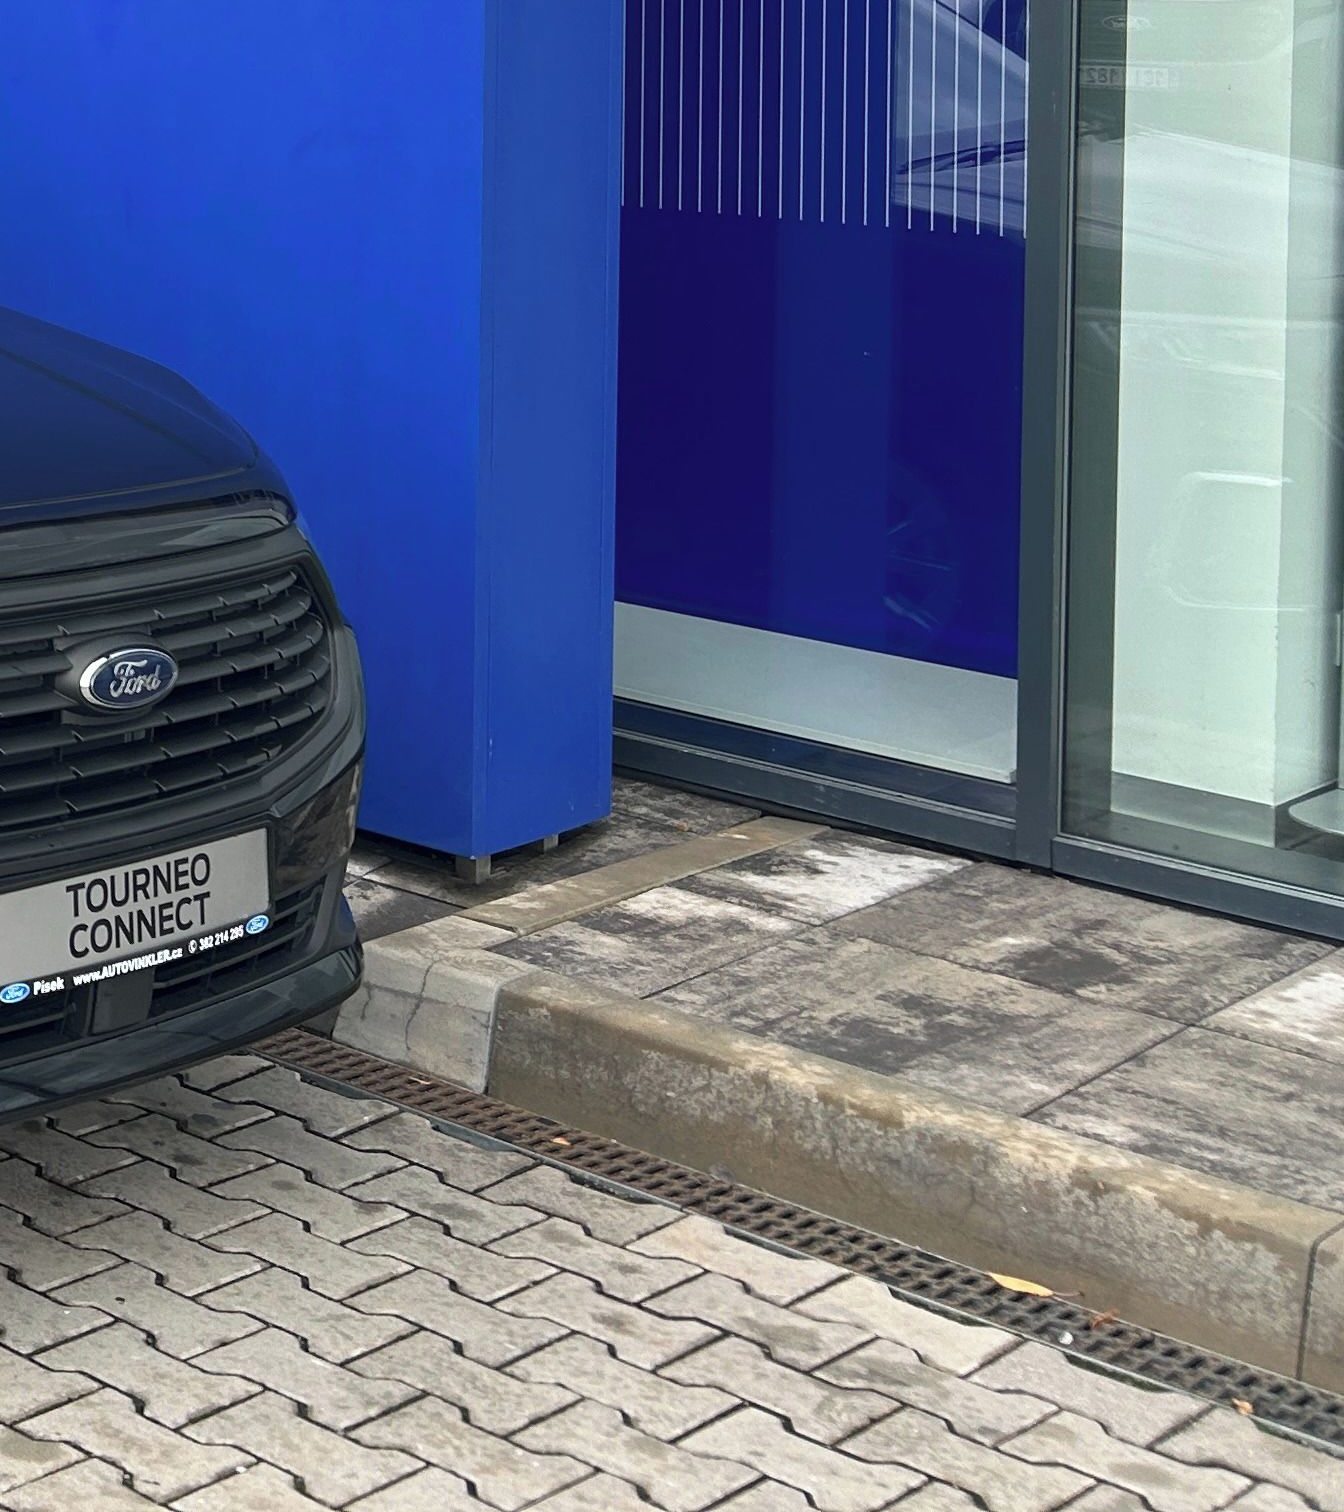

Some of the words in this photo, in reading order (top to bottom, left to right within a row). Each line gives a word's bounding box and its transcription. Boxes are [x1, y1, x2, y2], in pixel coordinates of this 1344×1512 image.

[110, 659, 162, 698] Ford
[66, 853, 211, 918] TOURNEO
[69, 891, 211, 959] CONNECT
